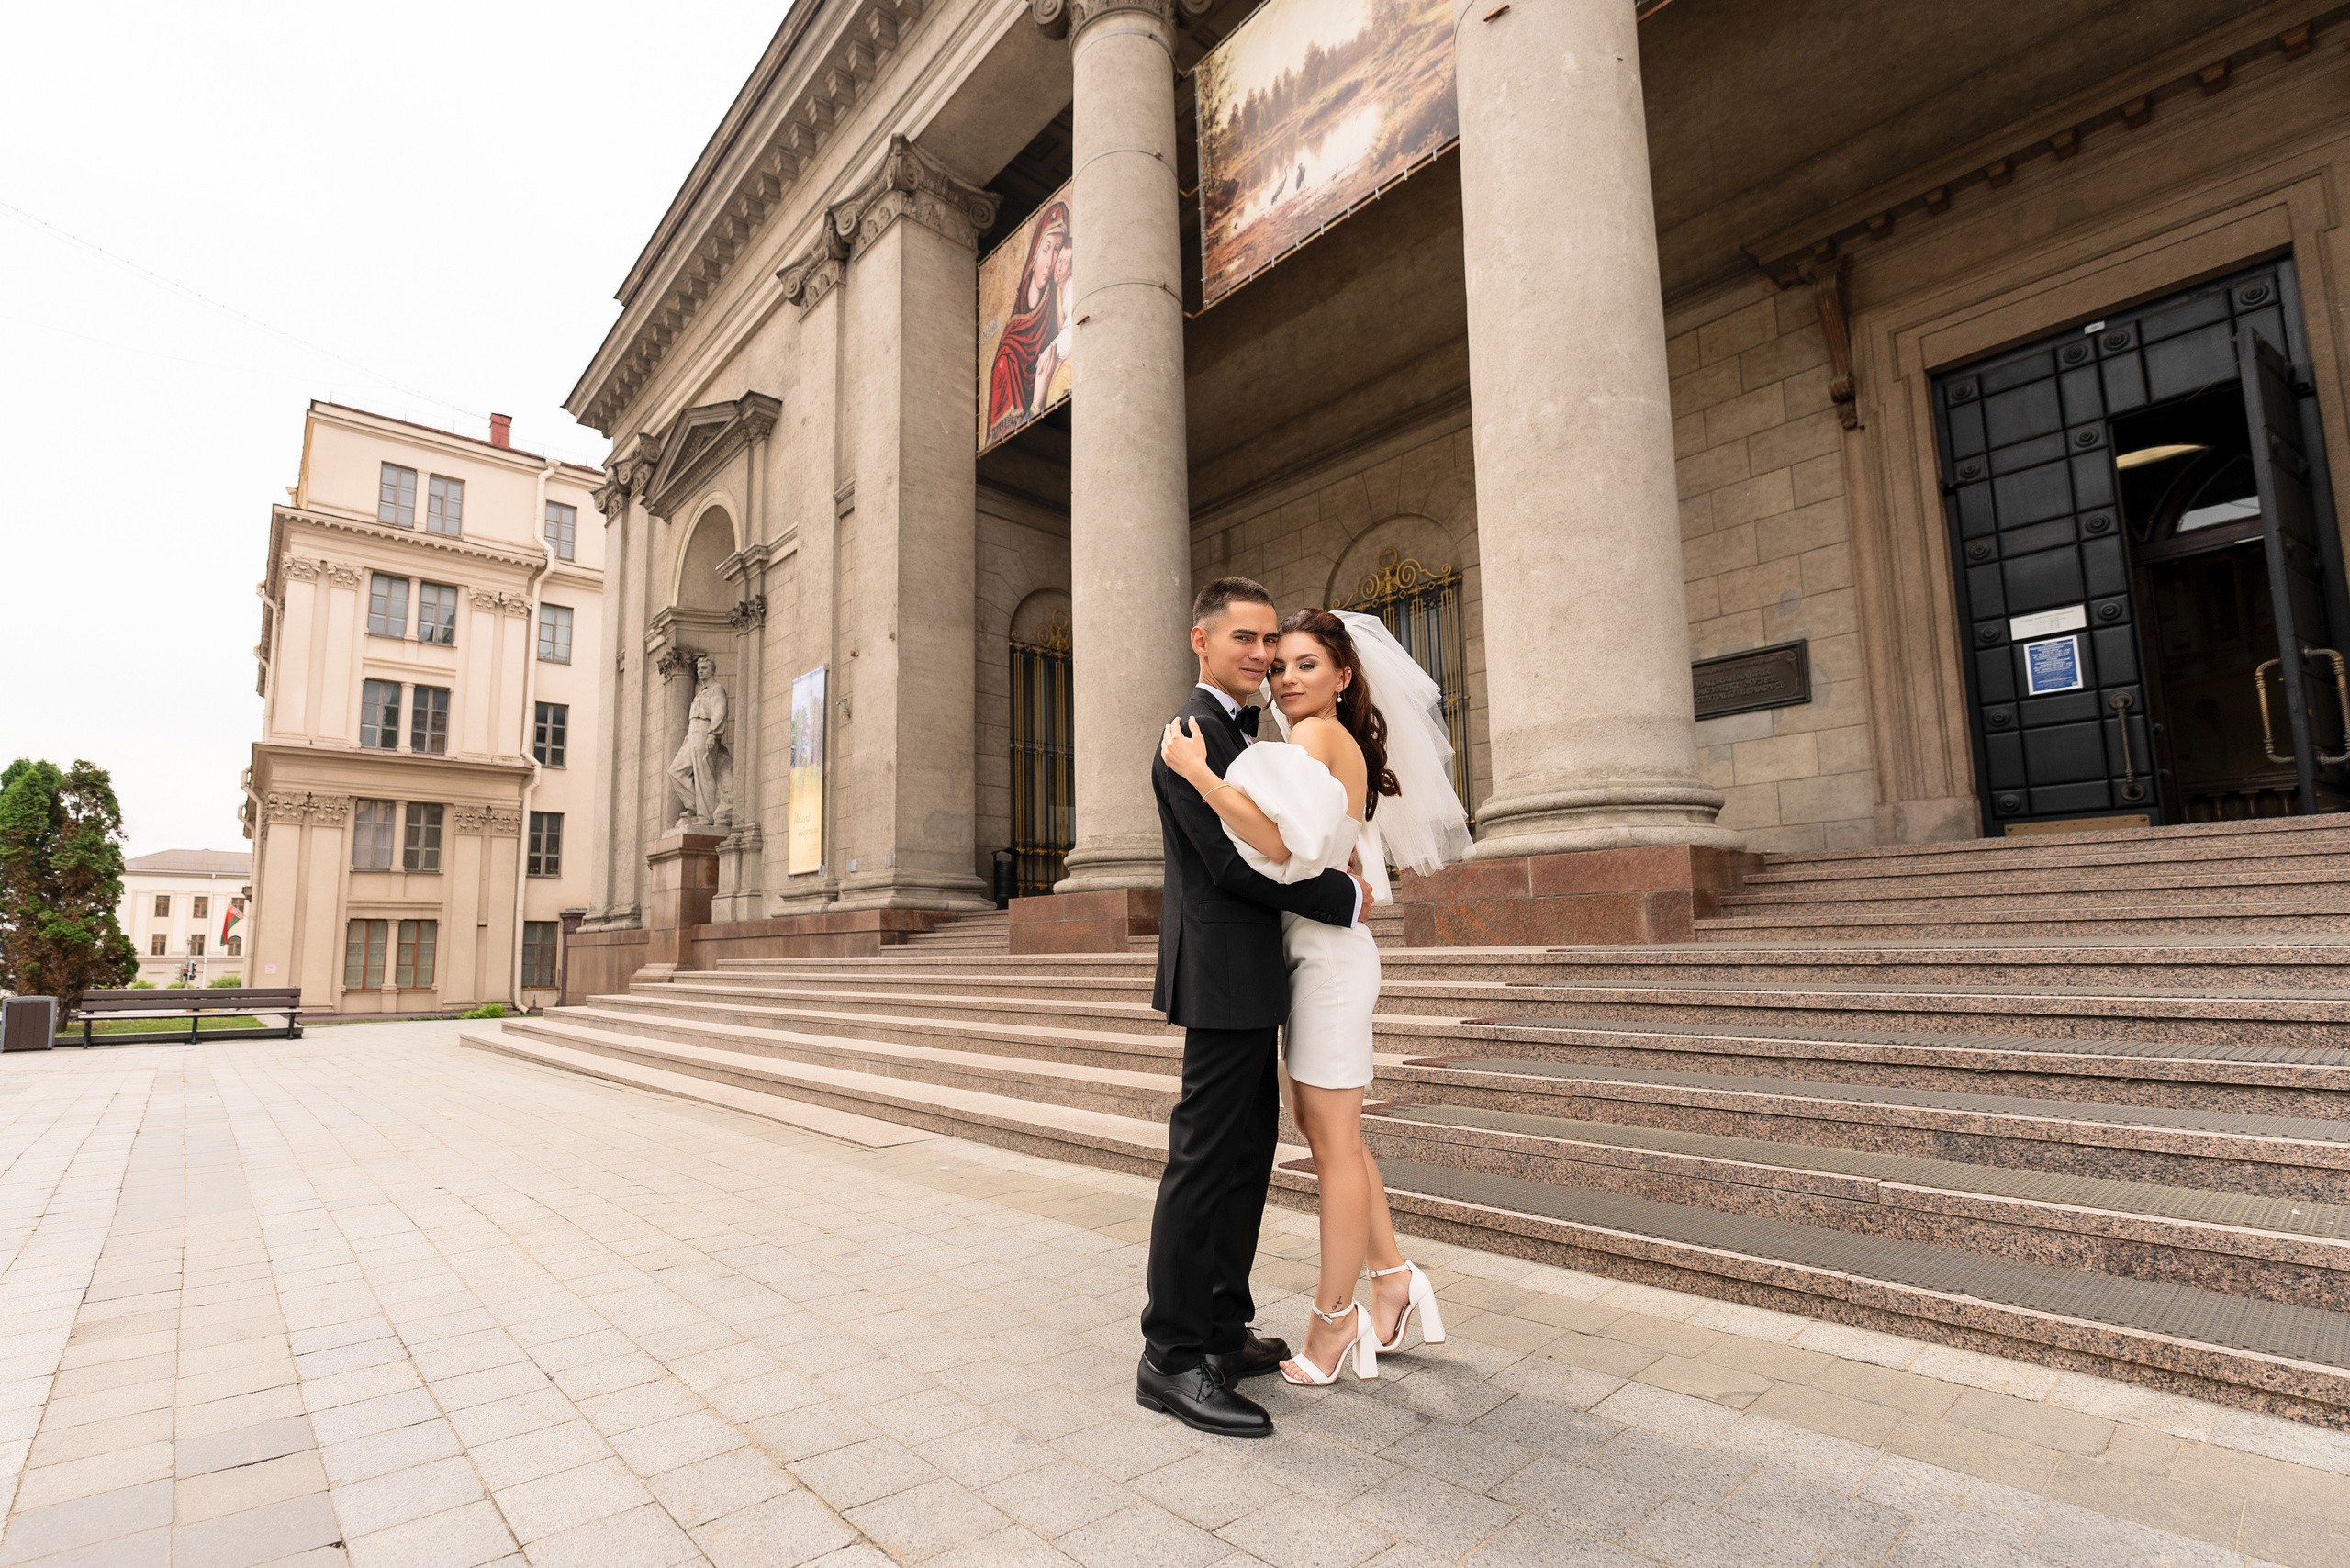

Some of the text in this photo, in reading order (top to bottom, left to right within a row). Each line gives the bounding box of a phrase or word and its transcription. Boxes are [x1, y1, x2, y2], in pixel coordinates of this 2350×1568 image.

[1743, 673, 1778, 688] МУЗЕЙ
[1695, 681, 1787, 704] СПУБЛІКІ БЕЛАРУСЬ
